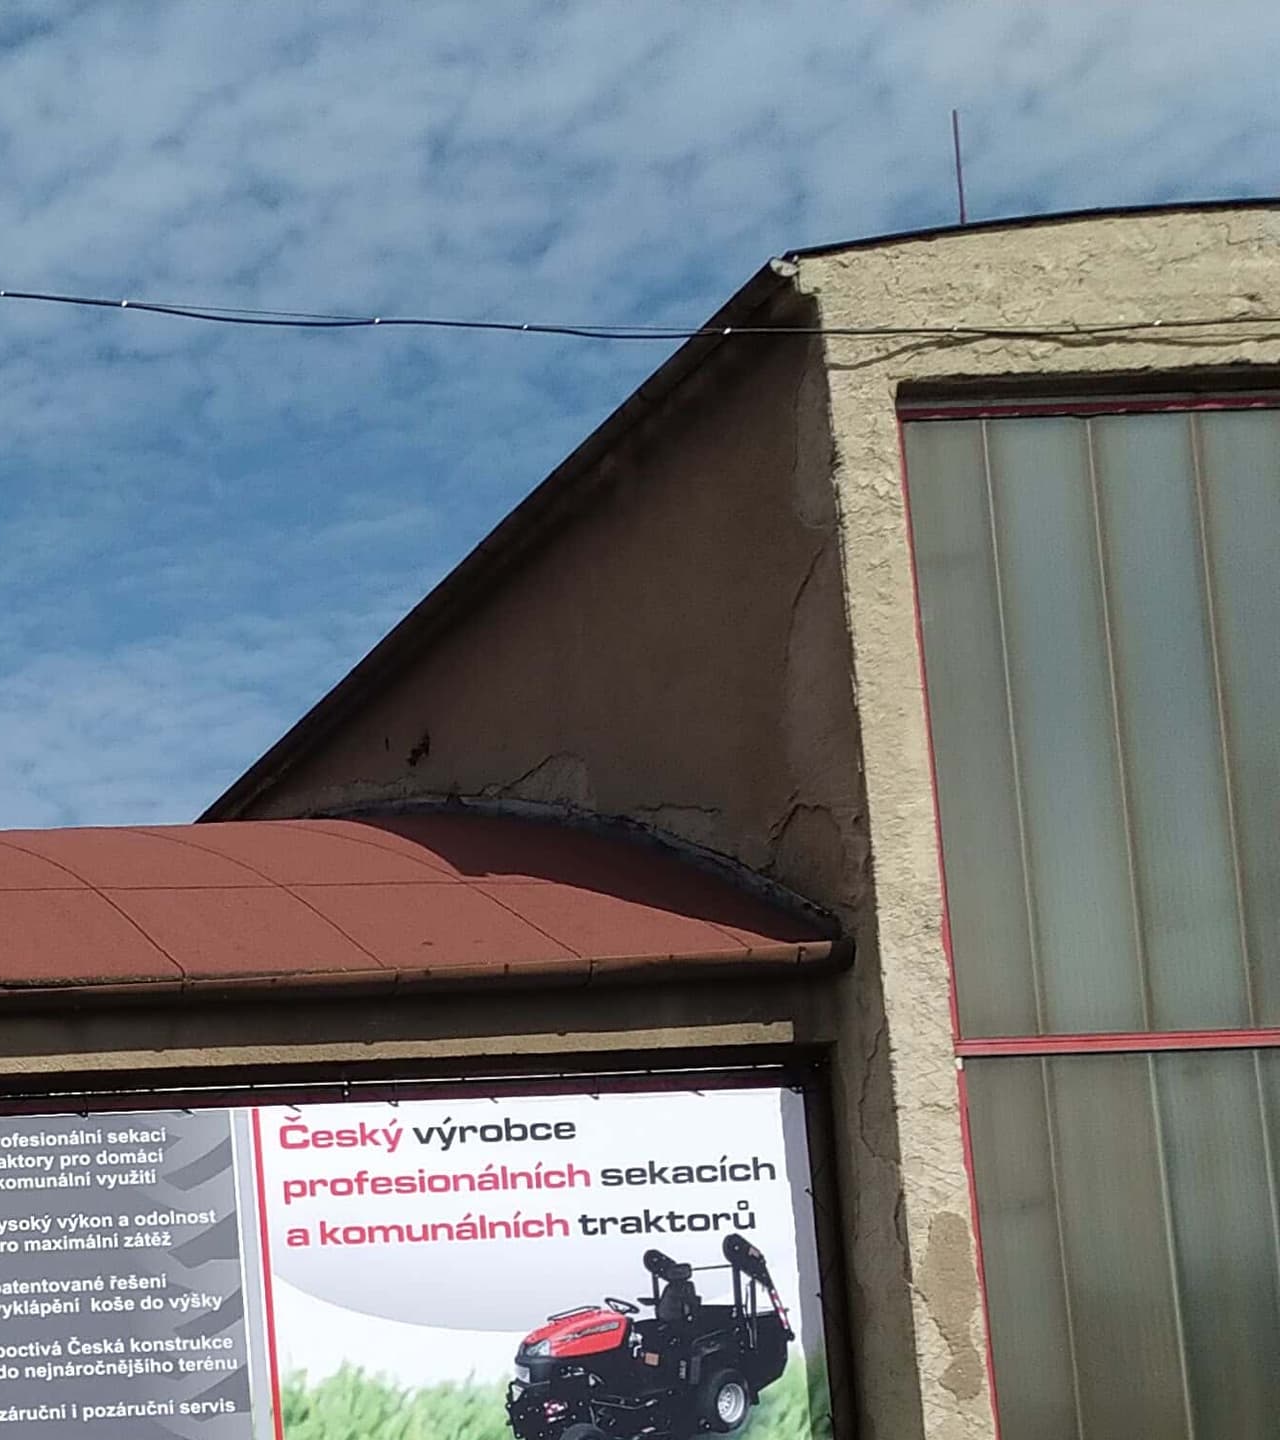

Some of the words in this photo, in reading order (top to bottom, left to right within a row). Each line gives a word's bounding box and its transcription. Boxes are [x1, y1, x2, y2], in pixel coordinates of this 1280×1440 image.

[107, 1127, 166, 1144] sekací
[278, 1115, 404, 1152] Český
[413, 1117, 576, 1151] výrobce
[60, 1153, 91, 1169] pro
[96, 1148, 164, 1165] domácí
[97, 1169, 157, 1188] využití
[282, 1161, 591, 1205] profesionálních
[600, 1156, 776, 1187] sekacích
[57, 1213, 113, 1232] výkon
[118, 1215, 129, 1227] a
[134, 1209, 217, 1226] odolnost
[286, 1225, 311, 1247] a
[318, 1211, 570, 1246] komunálních
[578, 1199, 756, 1236] traktorů
[24, 1233, 119, 1251] maximální
[123, 1232, 172, 1249] zátěž
[110, 1273, 167, 1291] řešení
[91, 1296, 135, 1312] koše
[140, 1295, 164, 1310] do
[169, 1292, 223, 1313] výšky
[67, 1336, 125, 1354] Česká
[130, 1336, 233, 1353] konstrukce
[24, 1357, 174, 1381] nejnáročnějšího
[178, 1356, 238, 1372] terénu
[72, 1403, 77, 1418] i
[83, 1400, 174, 1421] pozáruční
[179, 1397, 236, 1414] servis
